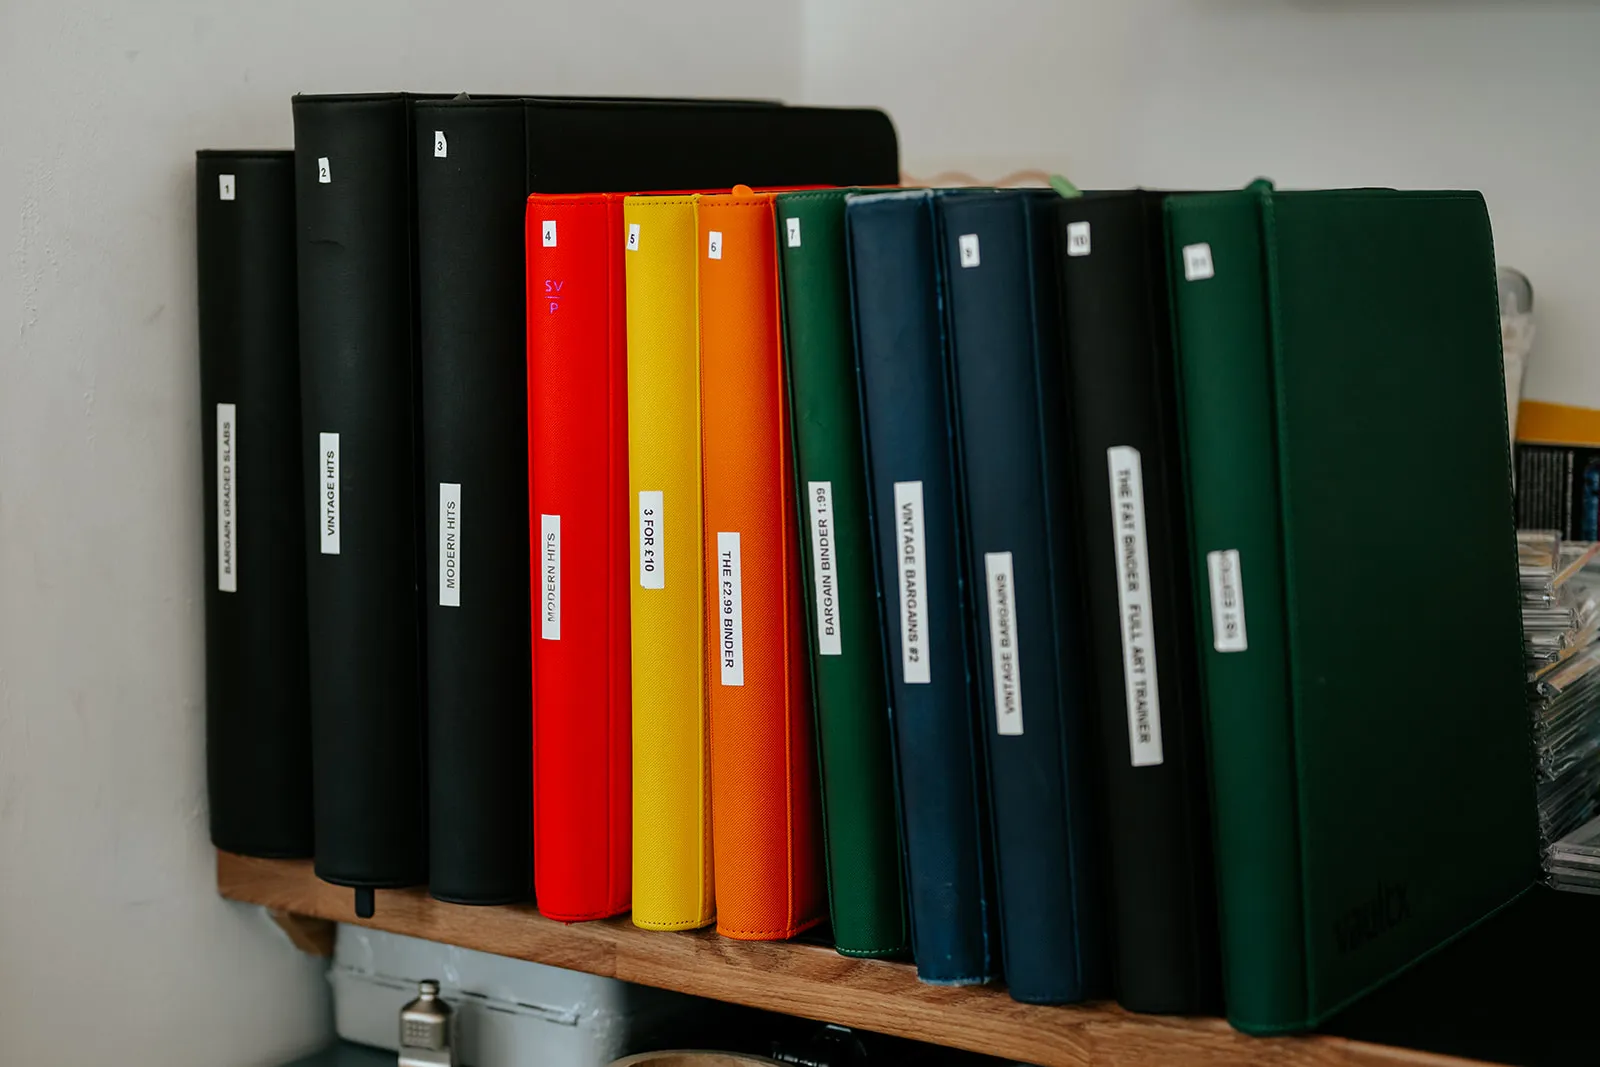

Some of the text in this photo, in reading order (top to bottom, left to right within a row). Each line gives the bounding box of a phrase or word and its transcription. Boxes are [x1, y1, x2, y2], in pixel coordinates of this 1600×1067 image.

[321, 167, 327, 178] 2
[437, 141, 443, 151] 3
[225, 184, 230, 195] 1
[545, 231, 552, 241] 4
[629, 233, 635, 244] 5
[711, 241, 717, 252] 6
[789, 229, 796, 240] 7
[545, 279, 564, 292] SV
[549, 301, 559, 315] P
[223, 422, 231, 574] BARGAIN GRADED SLABS
[326, 451, 335, 537] VINTAGE HITS
[446, 502, 456, 589] MODERN HITS
[643, 508, 655, 572] 3 FOR £10
[817, 520, 831, 571] BINDER
[546, 532, 556, 622] MODERN HITS
[902, 502, 920, 663] VINTAGE BARGAINS #2
[722, 550, 734, 669] THE £2.99 BINDER
[821, 575, 835, 636] BARGAIN
[1119, 469, 1151, 744] THE FAT BINDER FULL ART TRAINER
[996, 574, 1015, 714] VINTAGE BARGAINS
